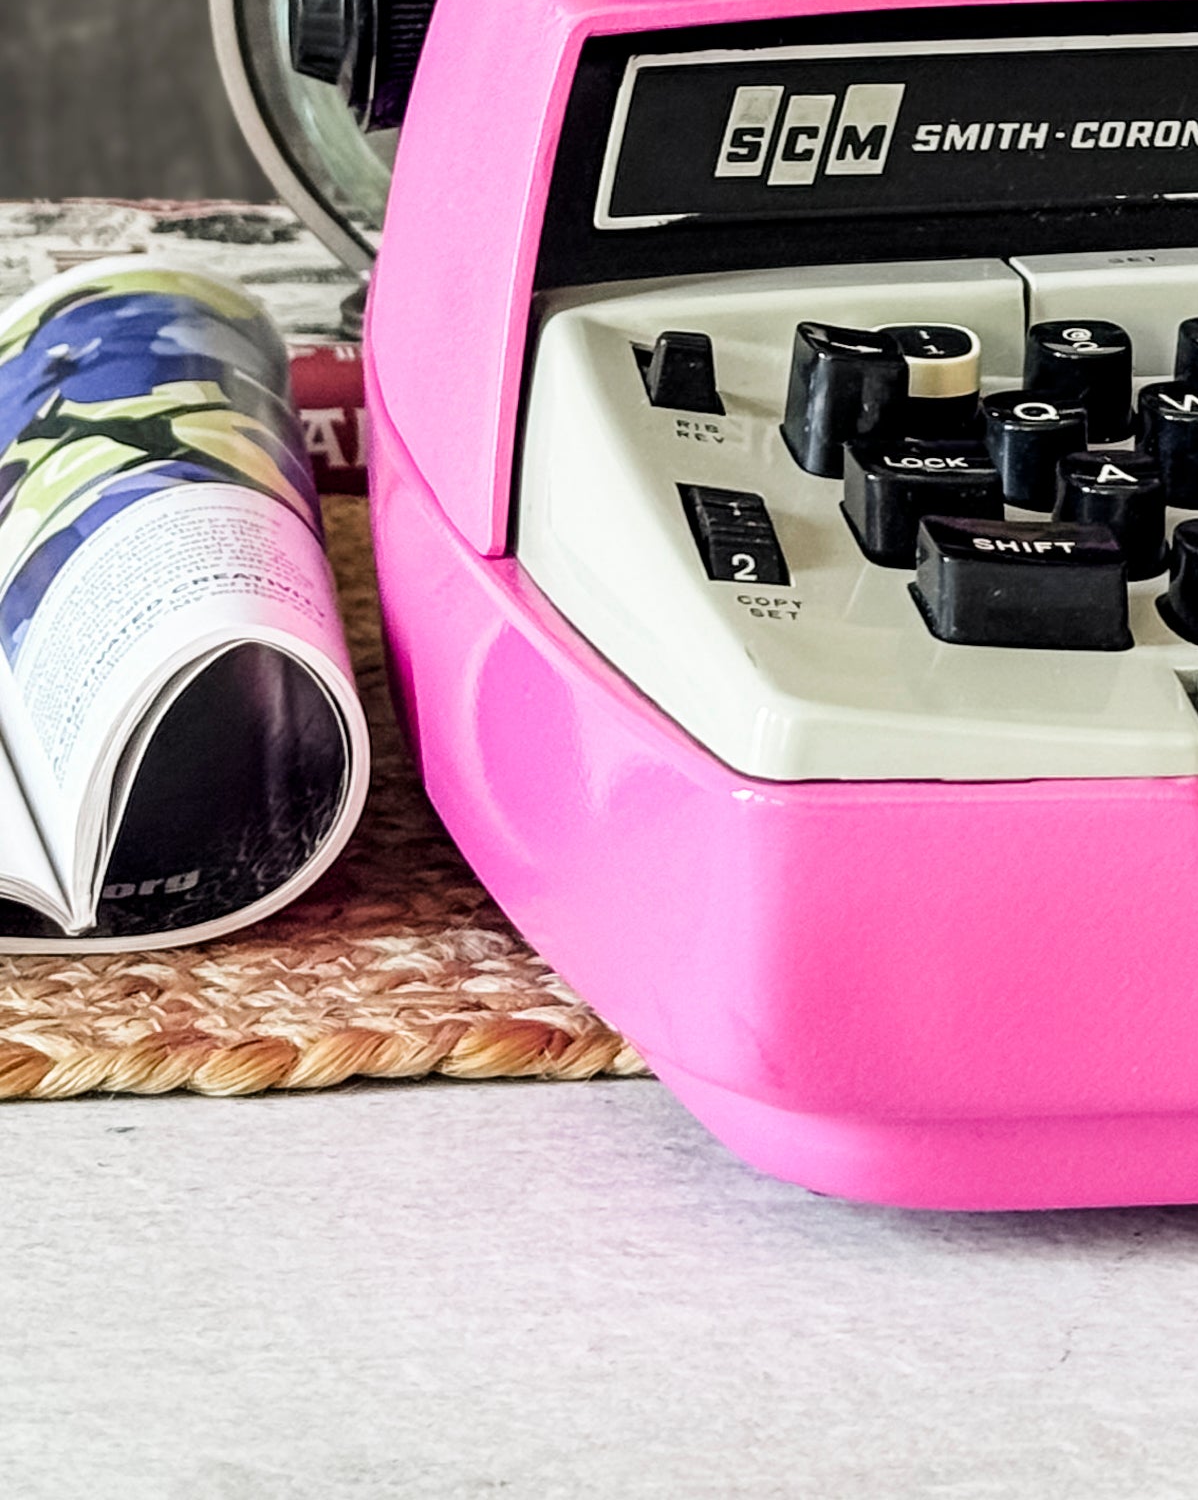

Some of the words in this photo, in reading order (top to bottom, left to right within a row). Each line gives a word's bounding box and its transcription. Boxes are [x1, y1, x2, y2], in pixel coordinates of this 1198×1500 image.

[724, 125, 890, 165] SCM
[1013, 402, 1059, 421] Q
[676, 419, 720, 434] RIB
[884, 455, 970, 470] LOCK
[1097, 464, 1138, 483] A
[973, 537, 1076, 555] SHIFT
[731, 552, 759, 581] 2
[737, 595, 802, 609] COPY
[749, 607, 798, 621] SET
